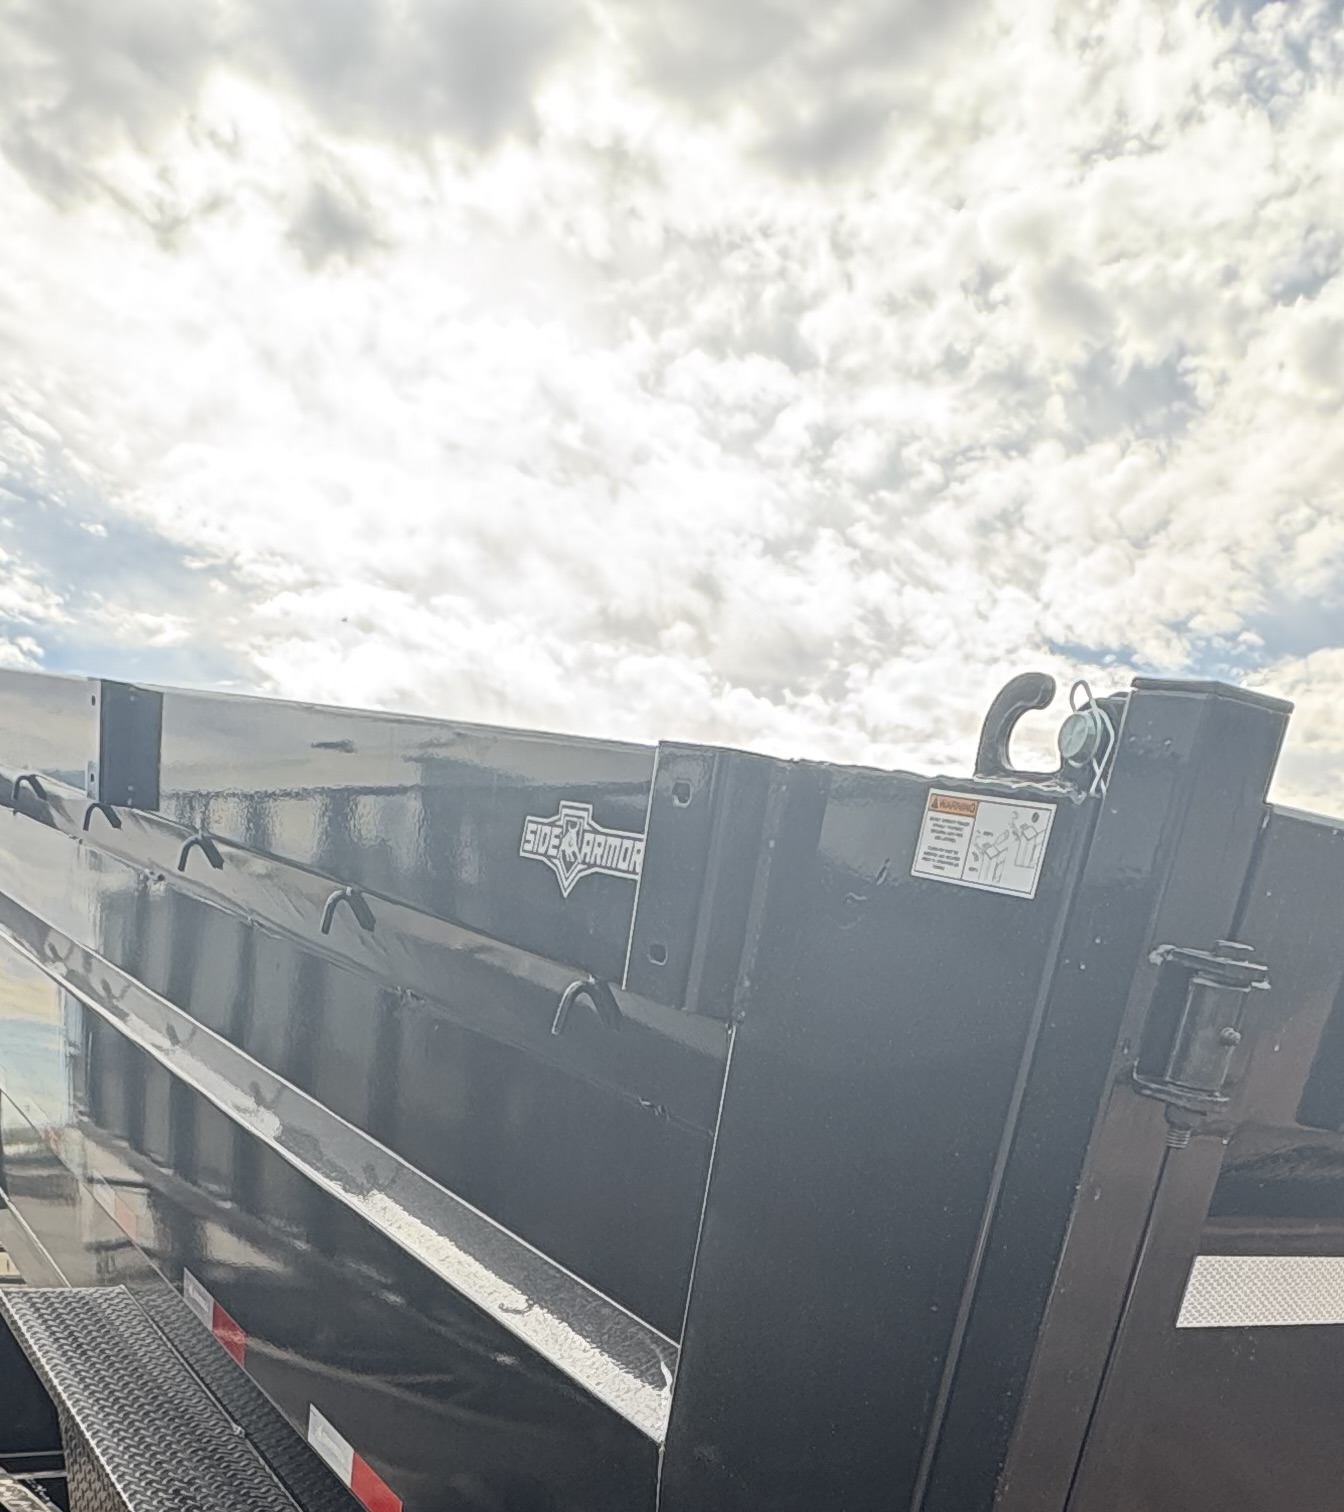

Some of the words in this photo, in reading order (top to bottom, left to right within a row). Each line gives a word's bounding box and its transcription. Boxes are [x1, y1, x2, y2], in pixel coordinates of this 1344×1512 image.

[938, 798, 976, 813] WARNING
[523, 823, 562, 857] SIDE
[580, 832, 645, 872] ARMOR
